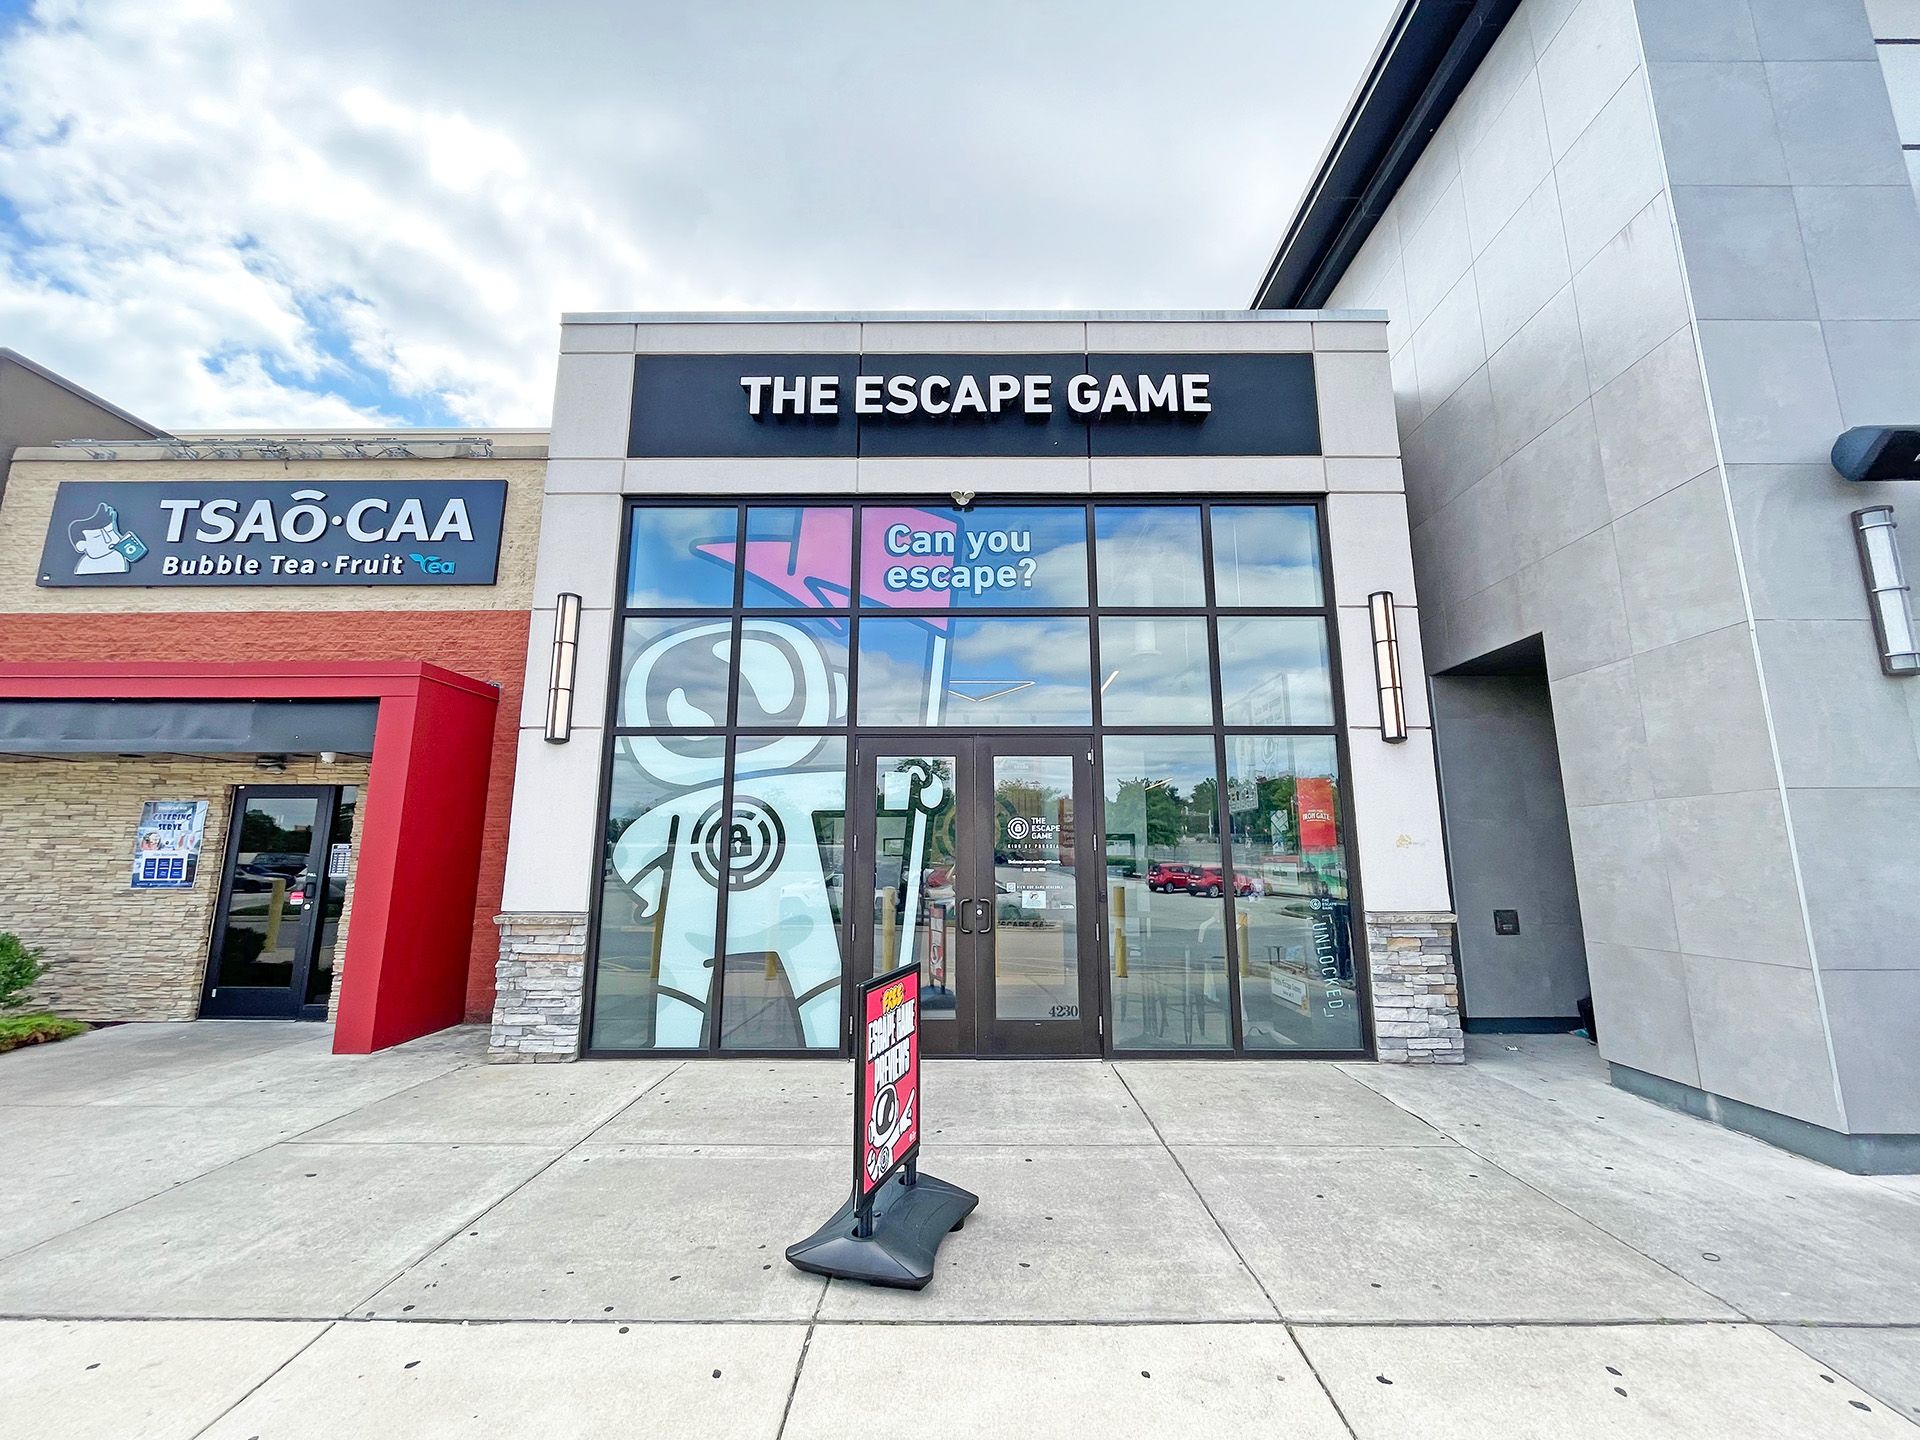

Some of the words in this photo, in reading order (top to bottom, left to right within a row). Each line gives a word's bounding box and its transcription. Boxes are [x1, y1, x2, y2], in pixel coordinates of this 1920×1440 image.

[740, 376, 839, 415] THE
[855, 375, 1053, 414] ESCAPE
[1067, 374, 1212, 413] GAME
[887, 524, 955, 554] Can
[966, 531, 1031, 560] you
[162, 554, 260, 576] Bubble
[887, 557, 1037, 595] escape?
[152, 813, 192, 821] CATERING
[1031, 832, 1053, 840] GAME
[1312, 922, 1344, 1009] UNLOCKED
[882, 982, 904, 1014] FREE
[1048, 1005, 1079, 1017] 4230
[867, 1011, 896, 1061] ESCAPE
[896, 998, 915, 1042] GAME
